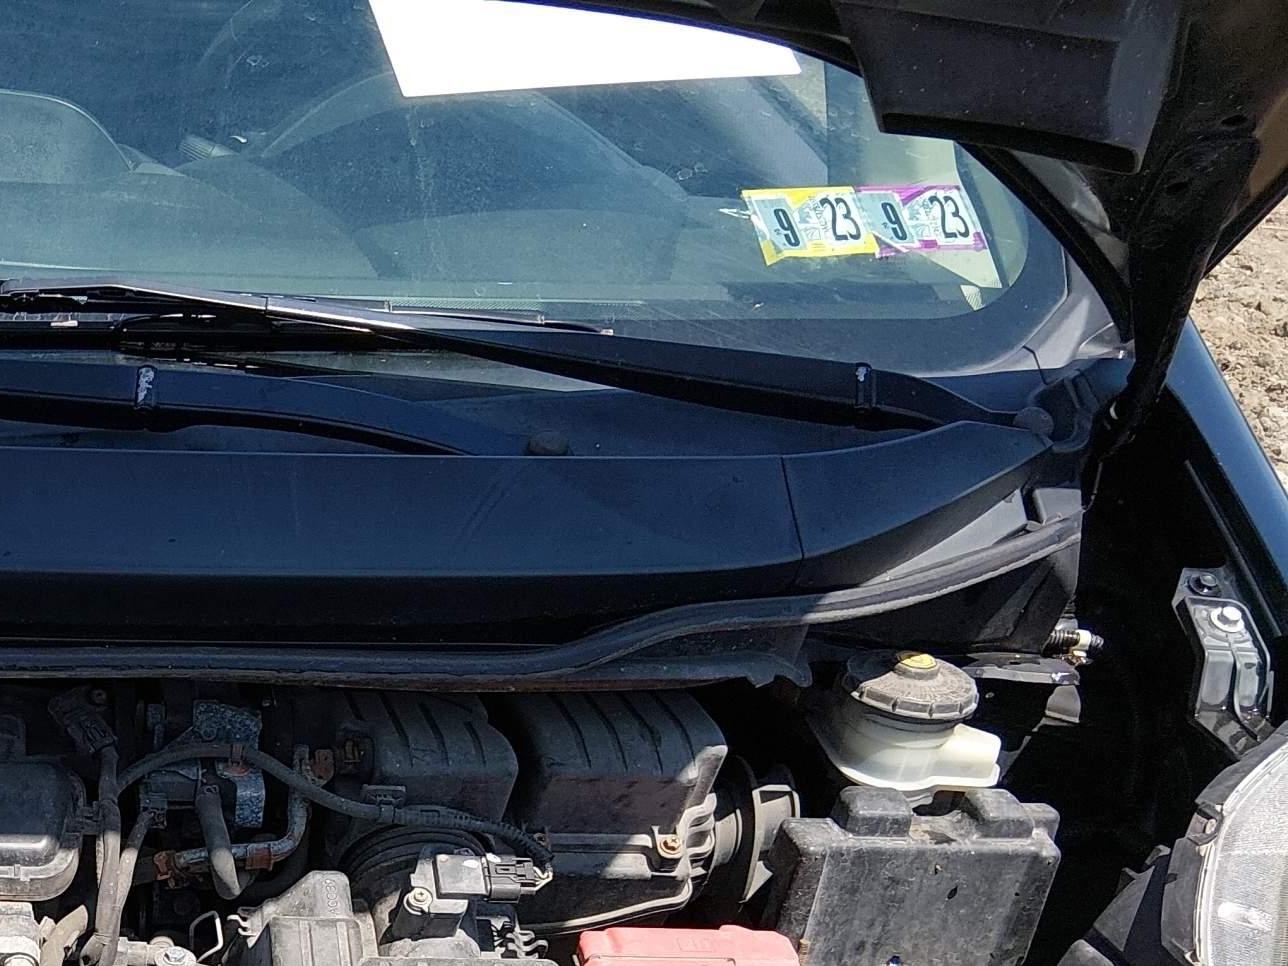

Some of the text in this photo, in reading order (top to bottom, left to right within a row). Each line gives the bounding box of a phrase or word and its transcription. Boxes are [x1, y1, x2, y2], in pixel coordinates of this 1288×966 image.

[773, 208, 801, 248] 9
[819, 196, 862, 241] 23
[881, 202, 908, 241] 9
[928, 195, 970, 239] 23
